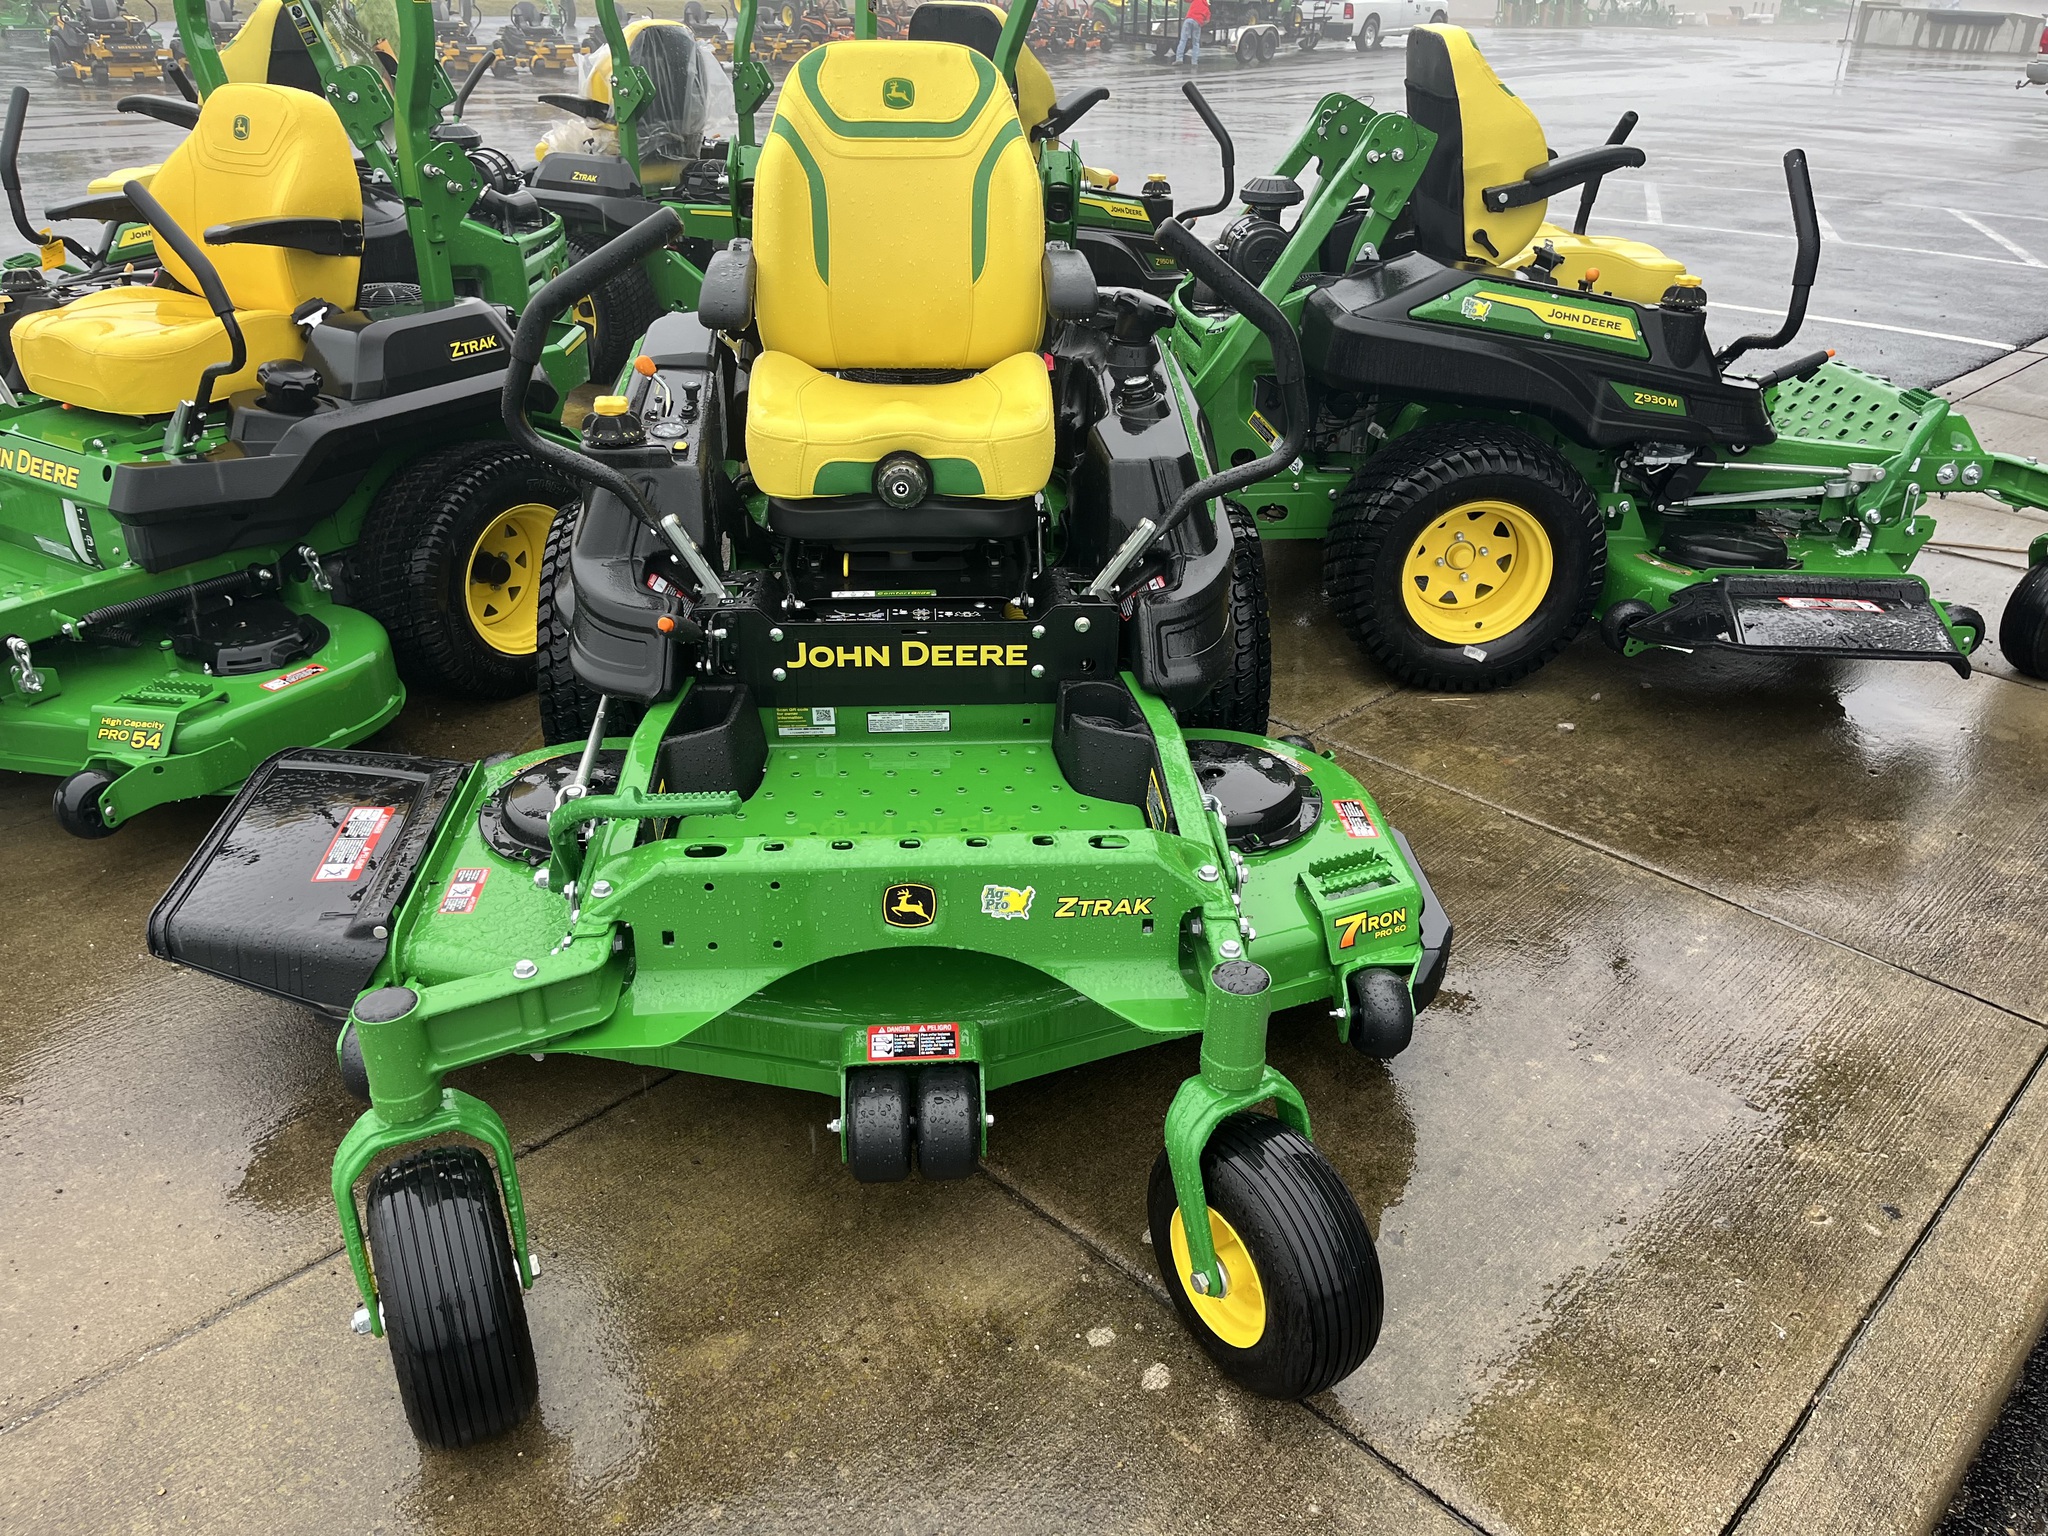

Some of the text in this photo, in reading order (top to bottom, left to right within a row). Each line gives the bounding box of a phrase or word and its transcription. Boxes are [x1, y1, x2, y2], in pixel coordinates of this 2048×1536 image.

[572, 171, 597, 183] ZTRAK
[1111, 206, 1142, 216] JOHN DEERE
[1547, 308, 1622, 331] JOHN DEERE
[449, 335, 497, 358] ZTRAK
[1633, 392, 1678, 408] Z930M
[16, 448, 80, 489] DEERE
[786, 640, 1028, 669] JOHN DEERE
[101, 717, 165, 731] High Capacity
[98, 728, 162, 750] PRO 54
[985, 887, 1009, 901] Ag-
[985, 899, 1009, 910] Pro
[1053, 896, 1154, 919] ZTRAK
[1374, 924, 1407, 940] PRO 60
[886, 1025, 911, 1033] DANGER
[926, 1024, 952, 1032] PELIGRO
